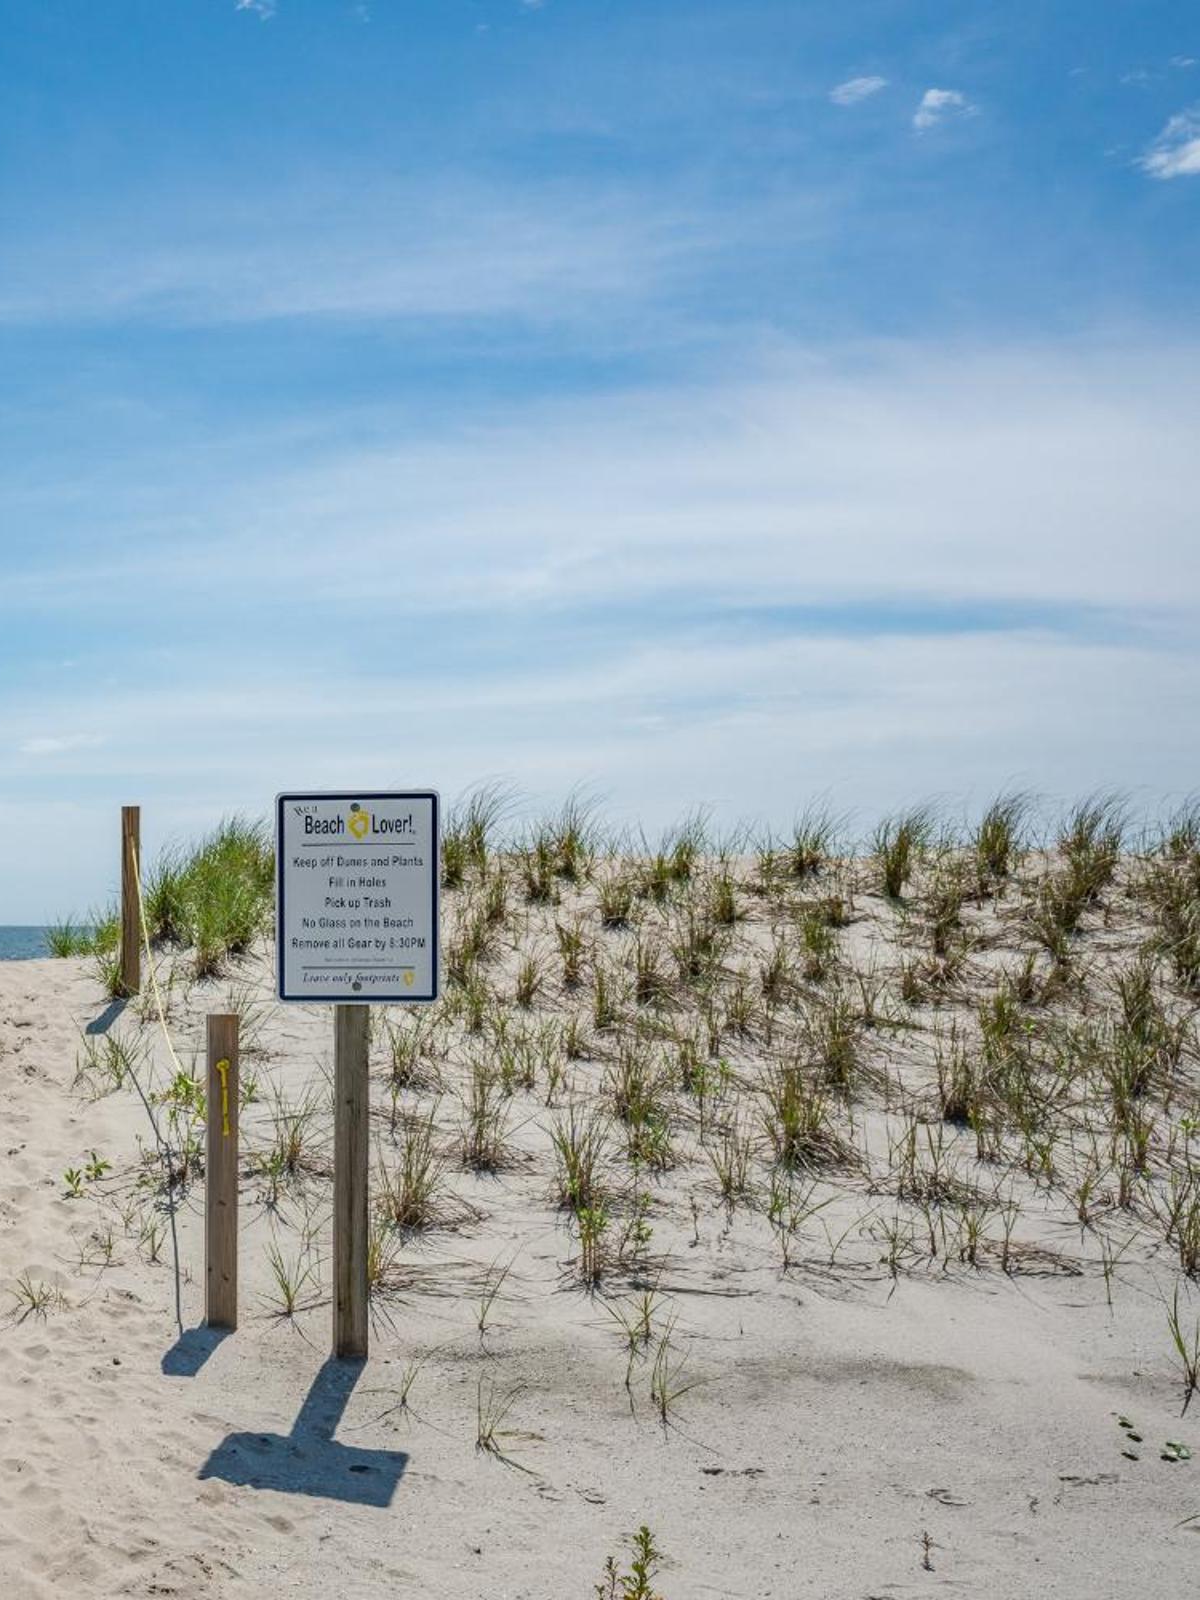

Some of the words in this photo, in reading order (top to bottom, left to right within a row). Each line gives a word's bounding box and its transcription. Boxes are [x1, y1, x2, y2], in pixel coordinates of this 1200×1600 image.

[304, 814, 345, 834] Beach
[293, 856, 317, 869] Keep
[320, 856, 334, 866] off
[337, 856, 368, 866] Dunes
[371, 856, 389, 866] and
[392, 856, 423, 866] Plants
[329, 877, 343, 888] Fill
[347, 877, 356, 888] in
[359, 877, 387, 888] Holes
[325, 897, 345, 908] Pick
[348, 899, 361, 910] up
[363, 897, 392, 908] Trash
[302, 917, 316, 928] No
[319, 917, 346, 928] Glass
[349, 920, 361, 928] on
[364, 917, 380, 928] the
[383, 917, 414, 928] Beach
[292, 937, 330, 948] Remove
[332, 937, 345, 948] all
[348, 937, 372, 948] Gear
[375, 938, 387, 950] by
[303, 972, 329, 983] Leave
[332, 972, 352, 984] only
[355, 972, 400, 984] footprints
